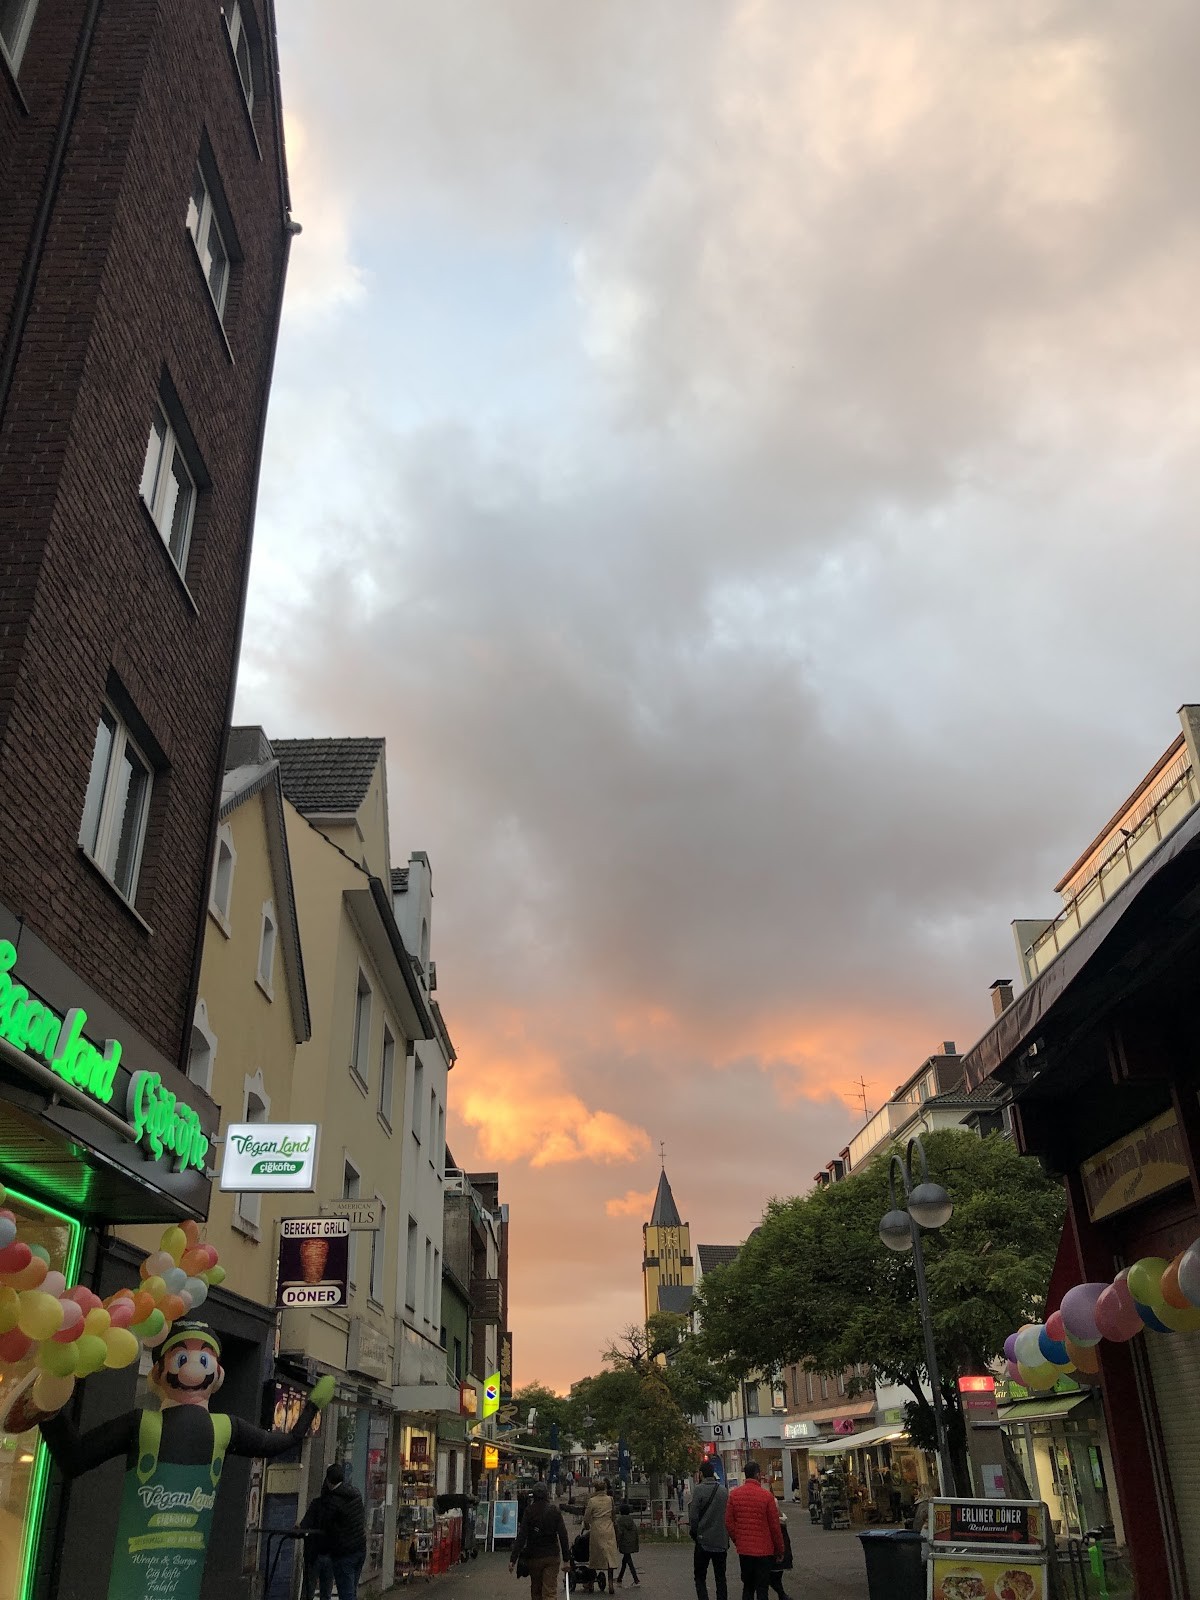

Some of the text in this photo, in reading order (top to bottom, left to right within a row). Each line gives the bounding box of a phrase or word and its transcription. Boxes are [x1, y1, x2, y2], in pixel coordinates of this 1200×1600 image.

[260, 1162, 296, 1173] çiğköfte
[284, 1222, 321, 1235] BEREKET
[287, 1289, 336, 1303] DÖNER
[956, 1507, 994, 1524] BERLINER
[996, 1506, 1021, 1524] DÖNER
[968, 1523, 1008, 1533] Restaurant
[147, 1580, 179, 1594] Falafel
